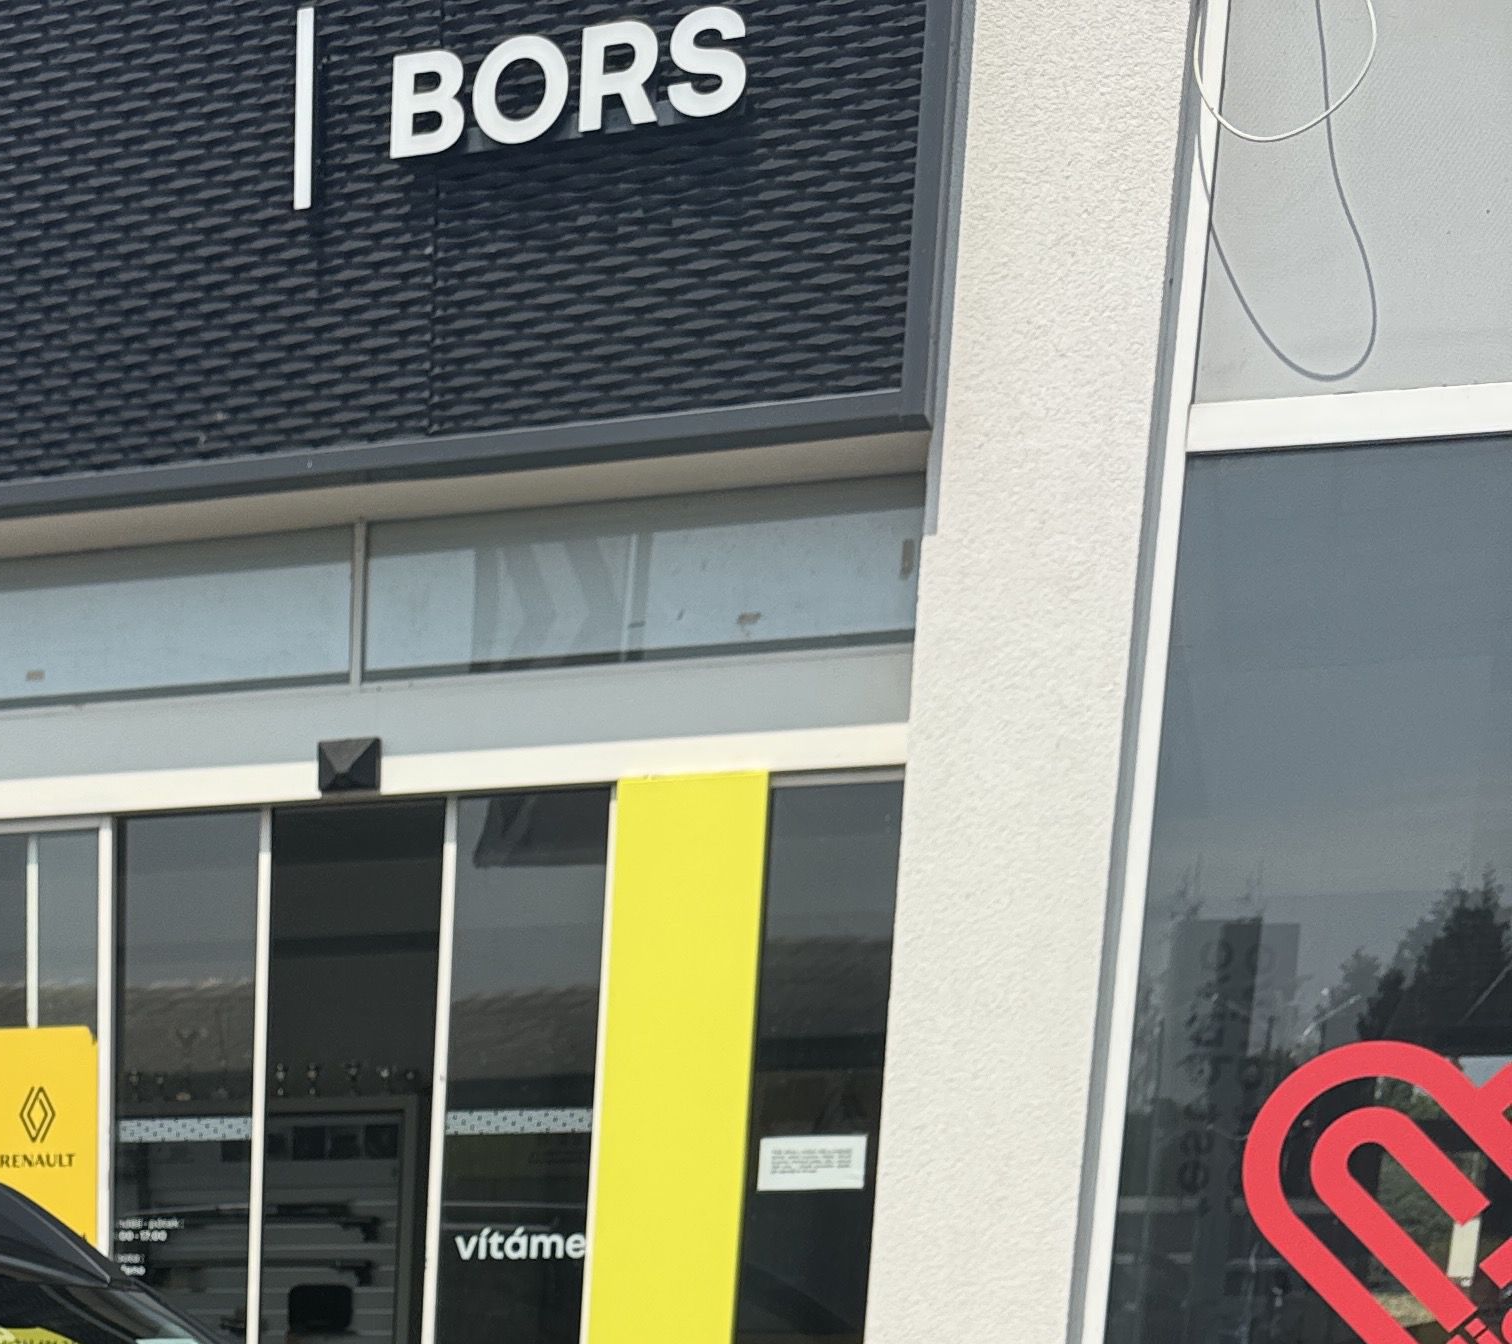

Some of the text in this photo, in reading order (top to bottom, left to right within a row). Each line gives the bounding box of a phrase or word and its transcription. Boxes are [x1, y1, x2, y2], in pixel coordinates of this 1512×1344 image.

[390, 6, 746, 159] BORS
[0, 1152, 76, 1168] RENAULT
[455, 1227, 587, 1260] vítáme
